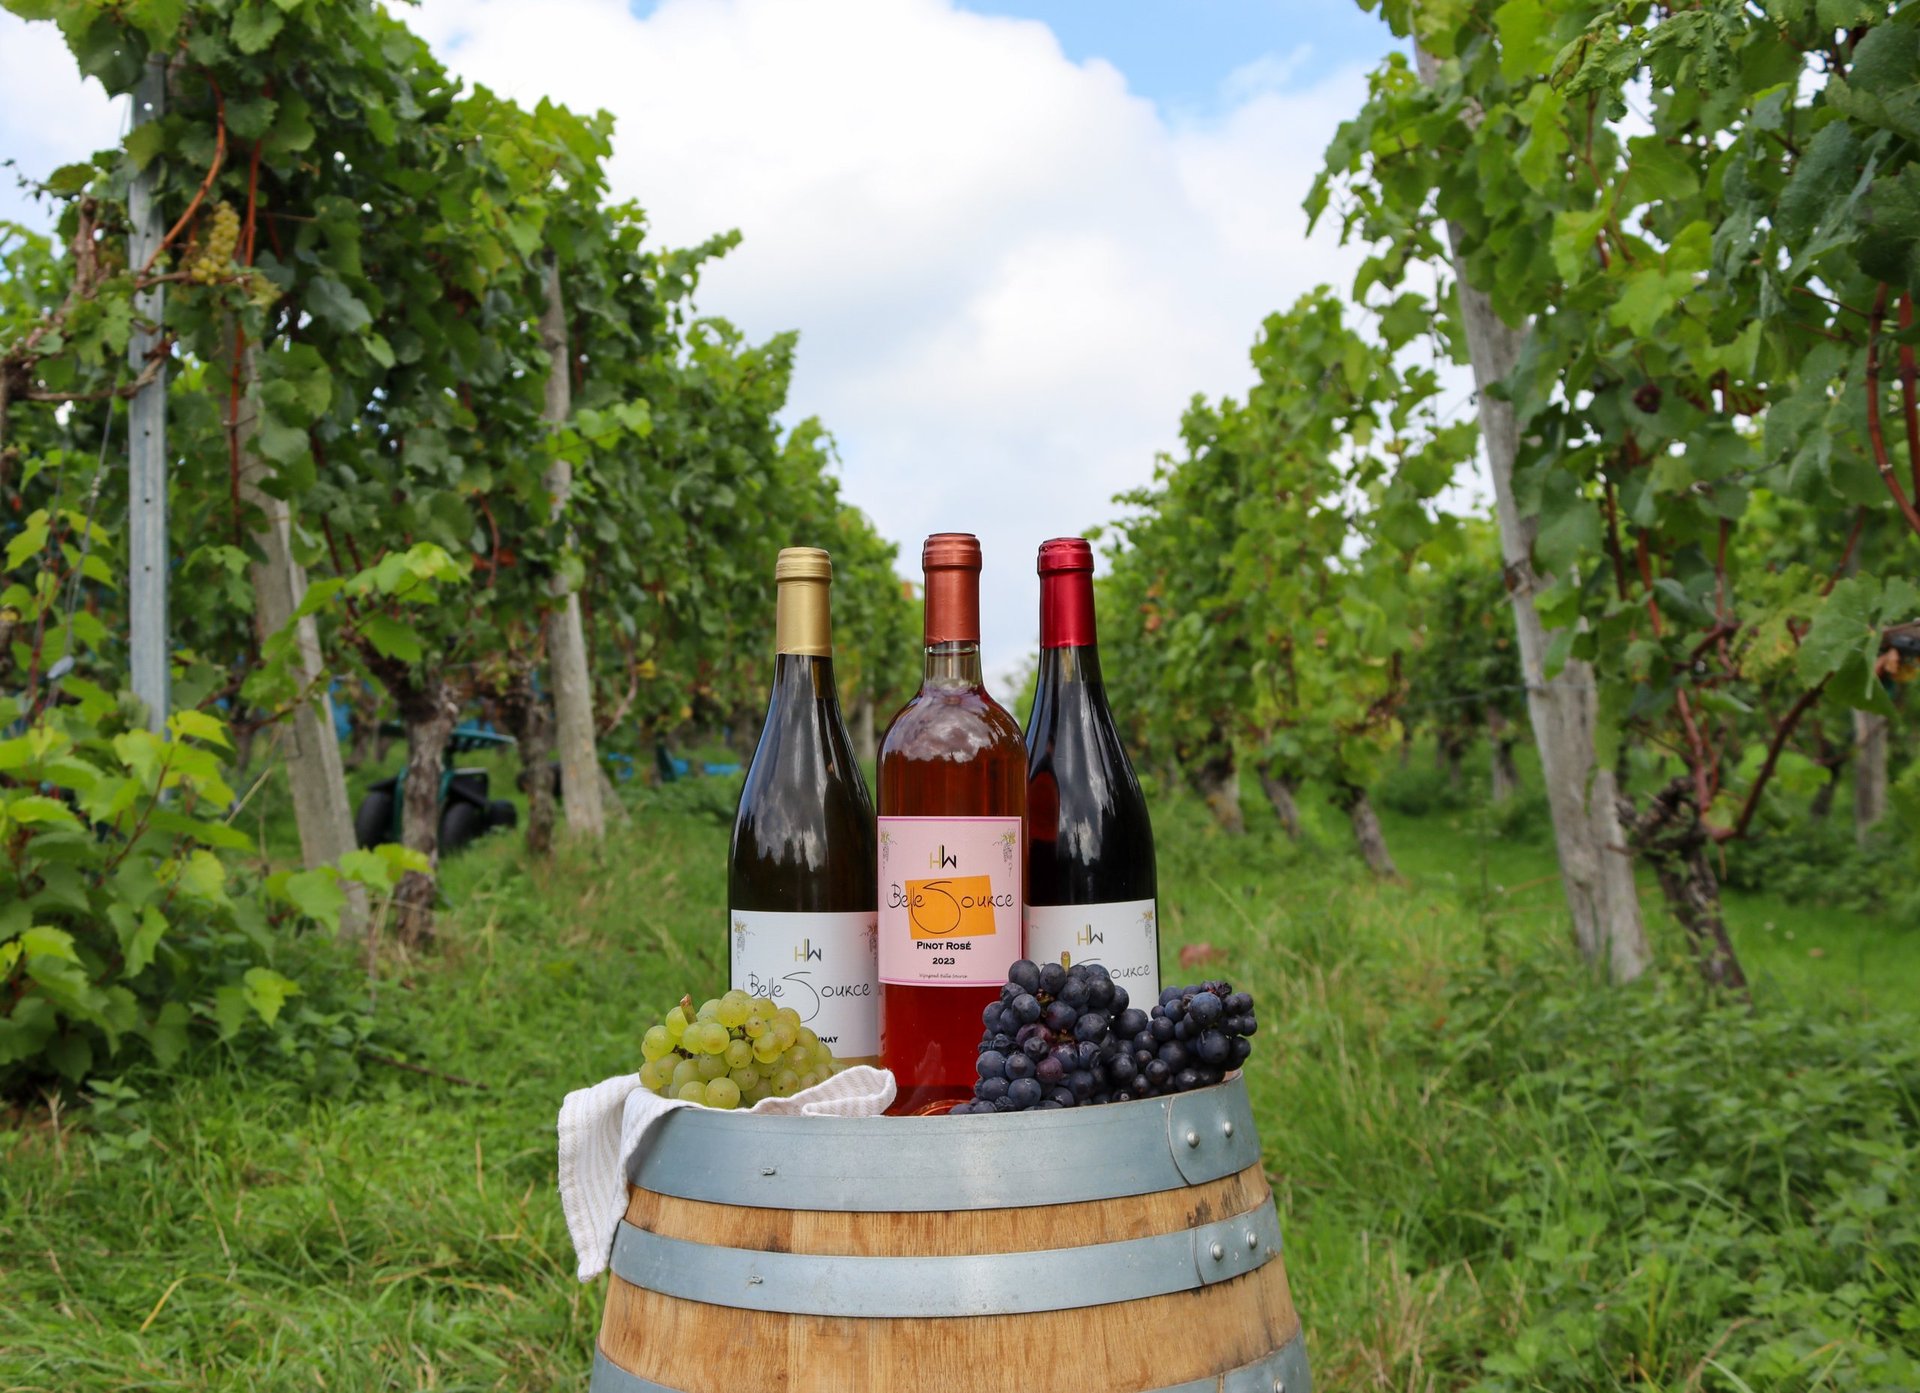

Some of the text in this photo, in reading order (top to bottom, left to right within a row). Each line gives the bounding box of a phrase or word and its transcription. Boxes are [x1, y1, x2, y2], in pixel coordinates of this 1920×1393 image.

[887, 881, 926, 908] Belle
[916, 941, 944, 950] PINOT
[932, 957, 956, 965] 2023
[743, 971, 785, 998] Belle
